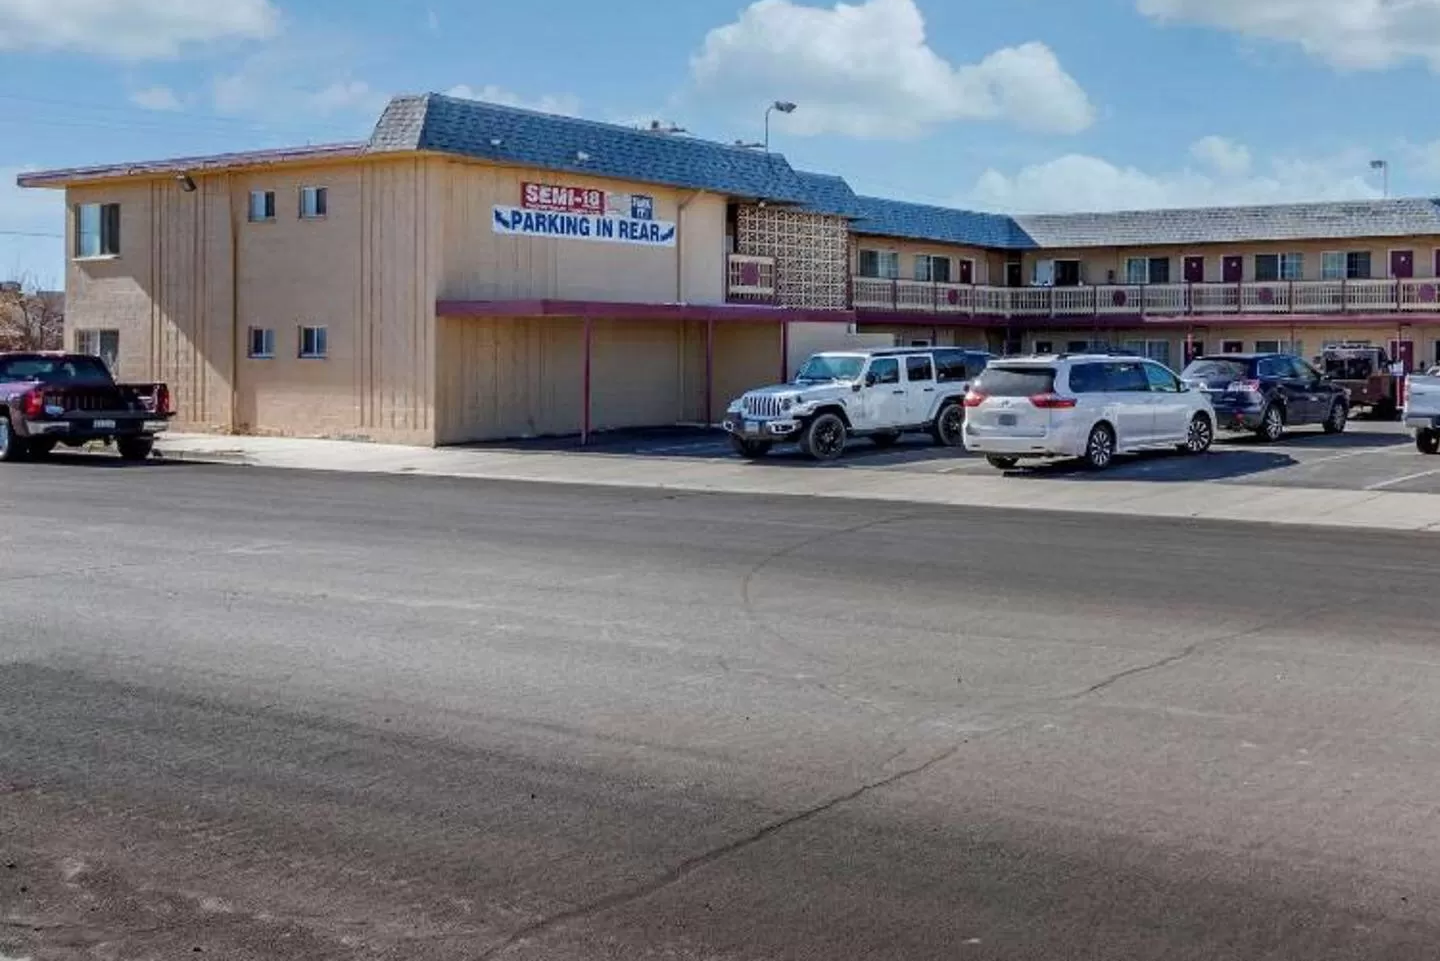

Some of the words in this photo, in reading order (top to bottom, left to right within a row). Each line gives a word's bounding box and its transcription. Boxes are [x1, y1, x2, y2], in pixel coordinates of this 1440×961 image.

[510, 209, 590, 237] PARKING
[596, 218, 613, 239] IN
[618, 220, 661, 242] REAR
